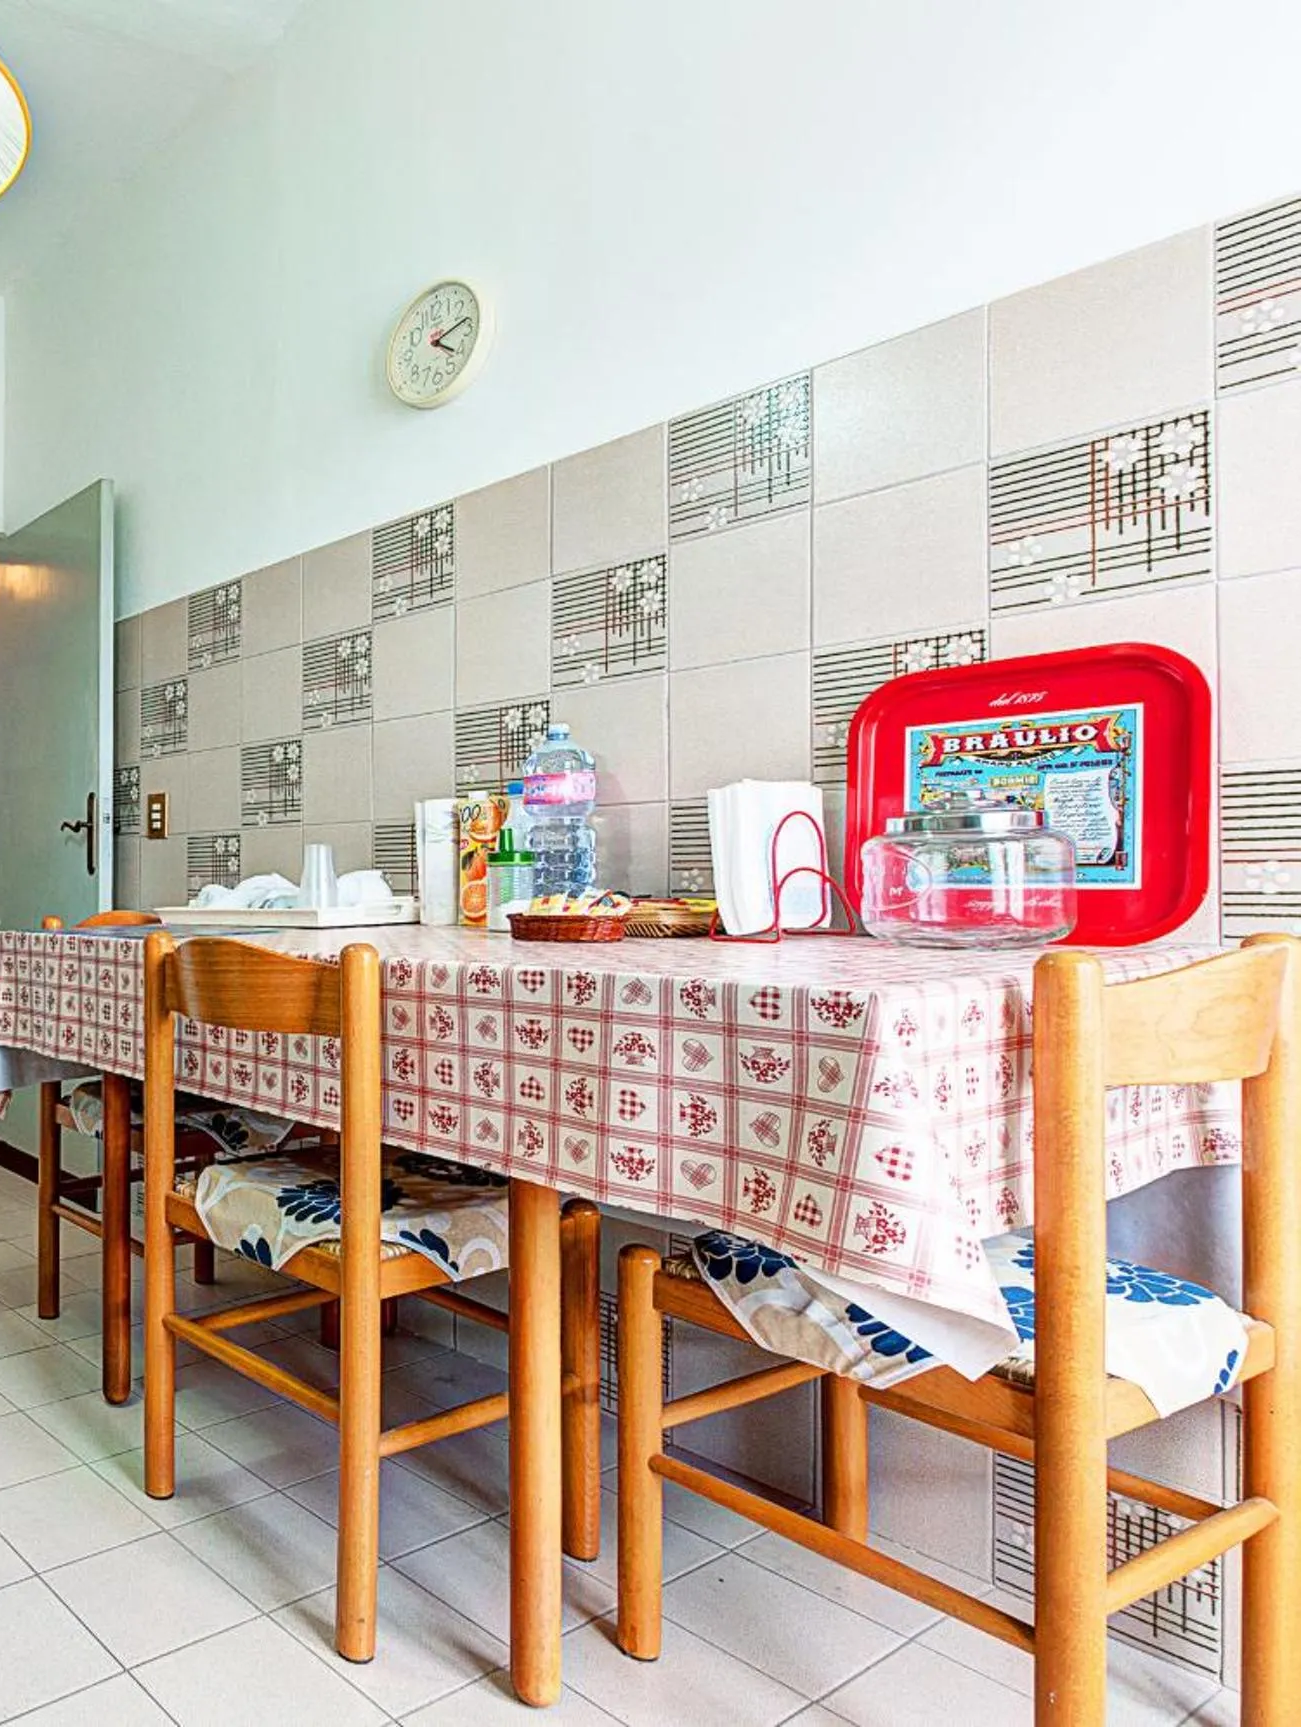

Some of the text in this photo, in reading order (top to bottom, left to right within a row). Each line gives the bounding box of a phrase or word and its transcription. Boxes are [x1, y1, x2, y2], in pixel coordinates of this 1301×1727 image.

[446, 356, 456, 375] 5
[422, 365, 431, 387] 7
[432, 370, 443, 385] 6
[942, 724, 1099, 753] BRAULIO
[460, 804, 481, 824] 00
